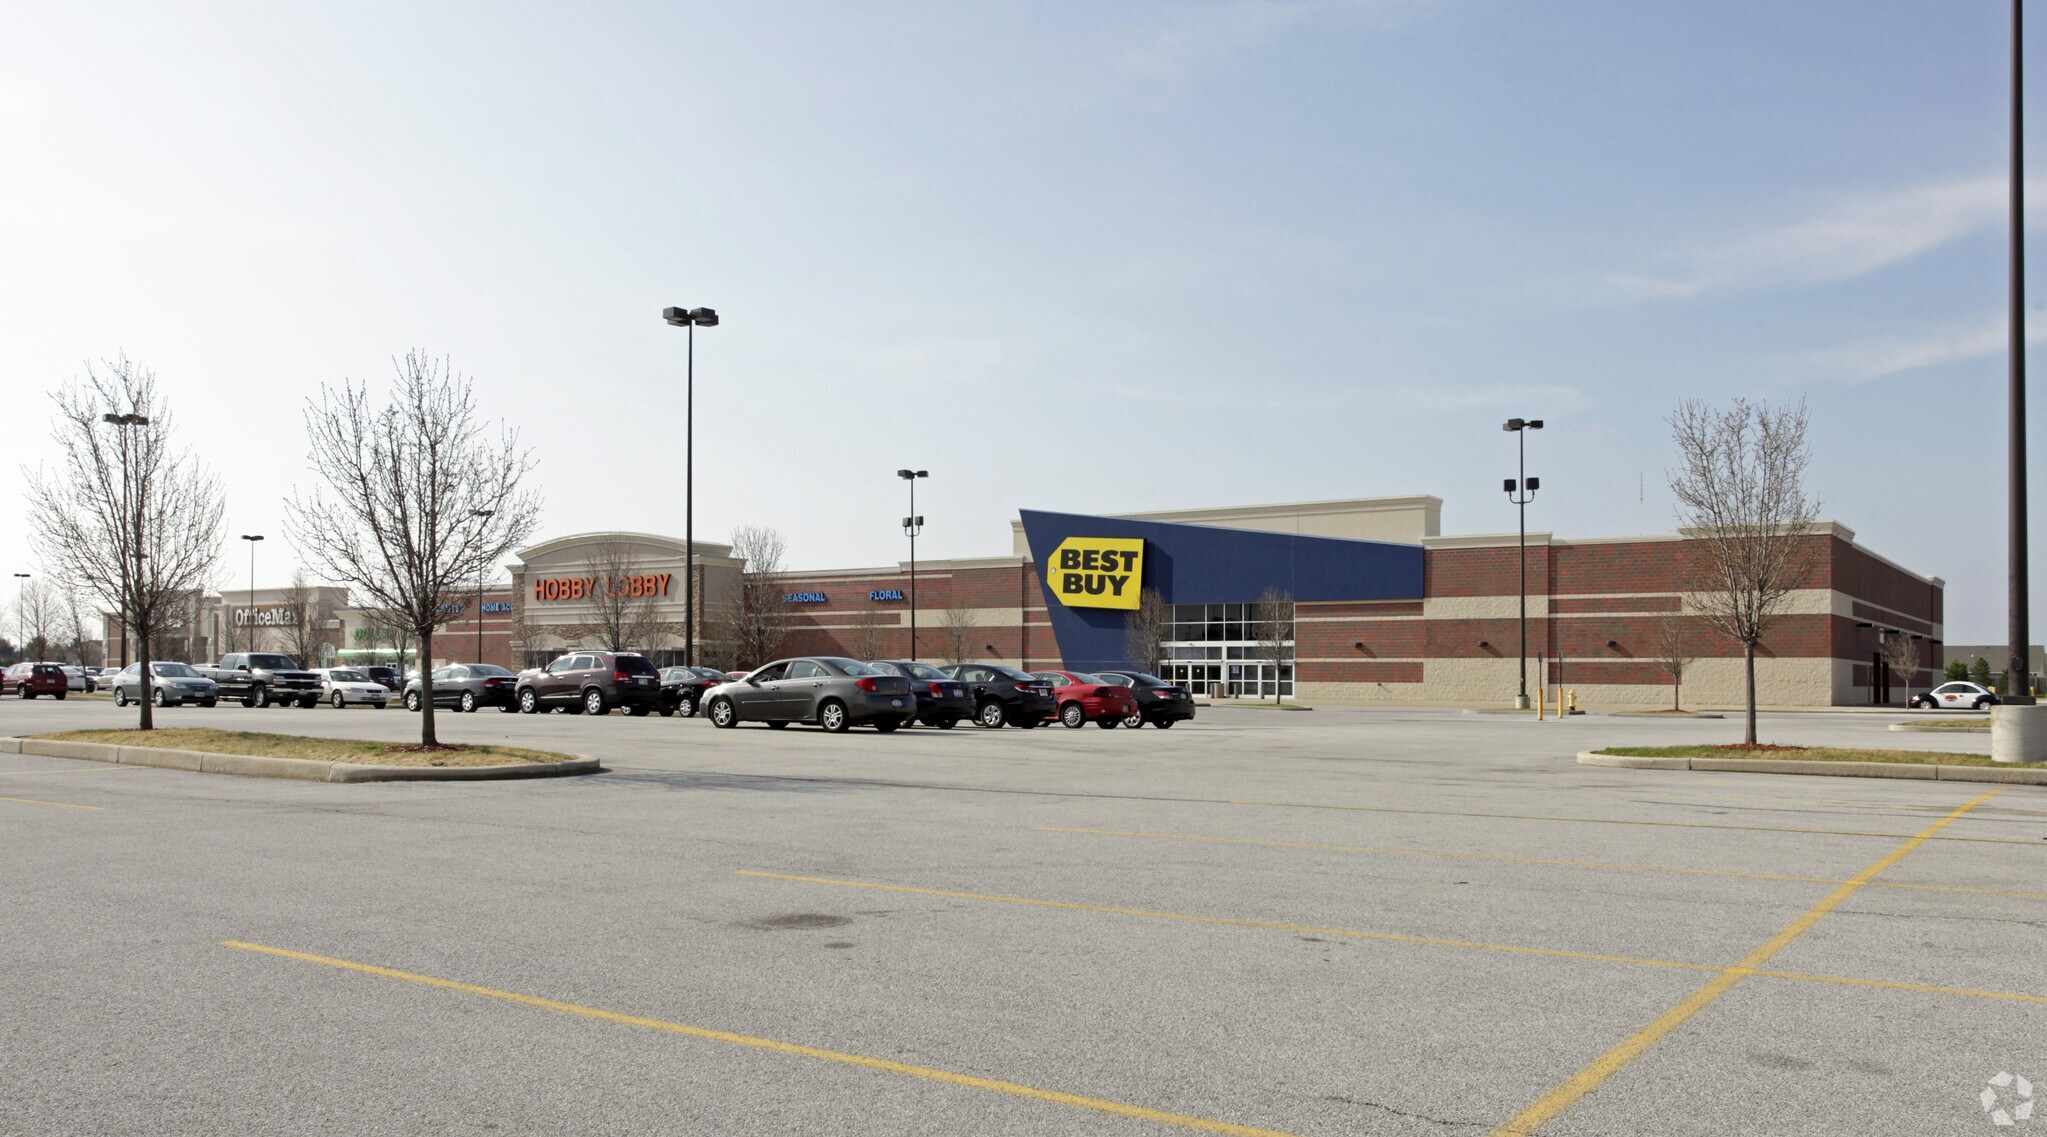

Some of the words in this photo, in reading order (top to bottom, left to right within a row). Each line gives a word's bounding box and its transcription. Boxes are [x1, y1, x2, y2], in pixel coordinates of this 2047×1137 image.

[1060, 548, 1139, 573] BEST
[533, 577, 595, 600] HOBBY
[605, 573, 672, 599] LOBBY
[1062, 572, 1131, 597] BUY
[783, 592, 827, 603] SEASONAL
[868, 589, 905, 601] FLORAL
[481, 602, 500, 612] HOME
